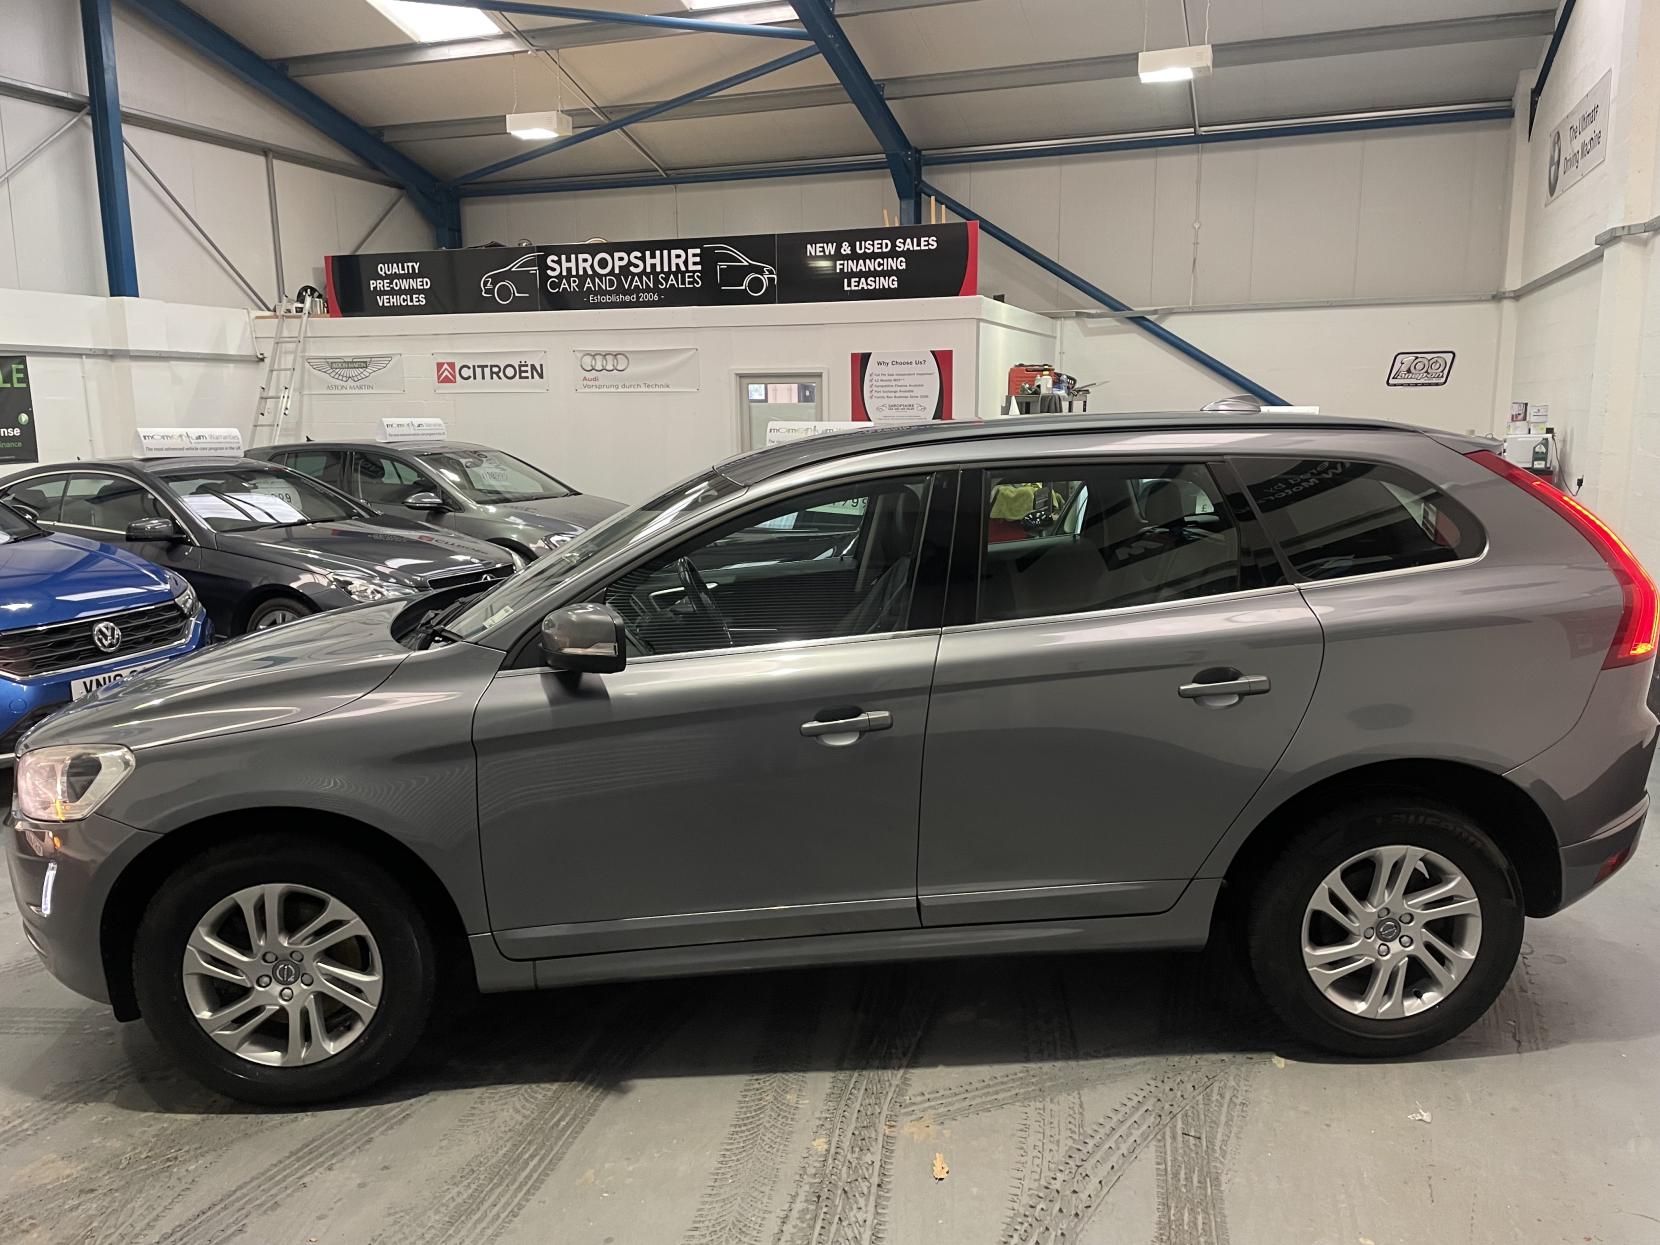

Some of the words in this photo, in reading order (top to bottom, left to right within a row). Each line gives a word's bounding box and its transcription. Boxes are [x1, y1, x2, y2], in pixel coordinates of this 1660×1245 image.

[806, 243, 837, 257] NEW
[840, 241, 852, 254] &
[855, 239, 892, 253] USED
[895, 236, 938, 251] SALES
[377, 262, 420, 276] QUALITY
[546, 248, 702, 276] SHROPSHIRE
[836, 256, 906, 272] FINANCING
[369, 278, 431, 291] PRE-OWNED
[546, 278, 579, 293] CAR
[583, 276, 617, 291] AND
[620, 274, 654, 290] VAN
[658, 272, 702, 289] SALES
[843, 275, 898, 291] LEASING
[376, 294, 426, 307] VEHICLES
[589, 293, 636, 303] Established
[639, 292, 659, 302] 2006
[458, 361, 544, 381] CITROËN
[582, 382, 619, 390] Vorsprung
